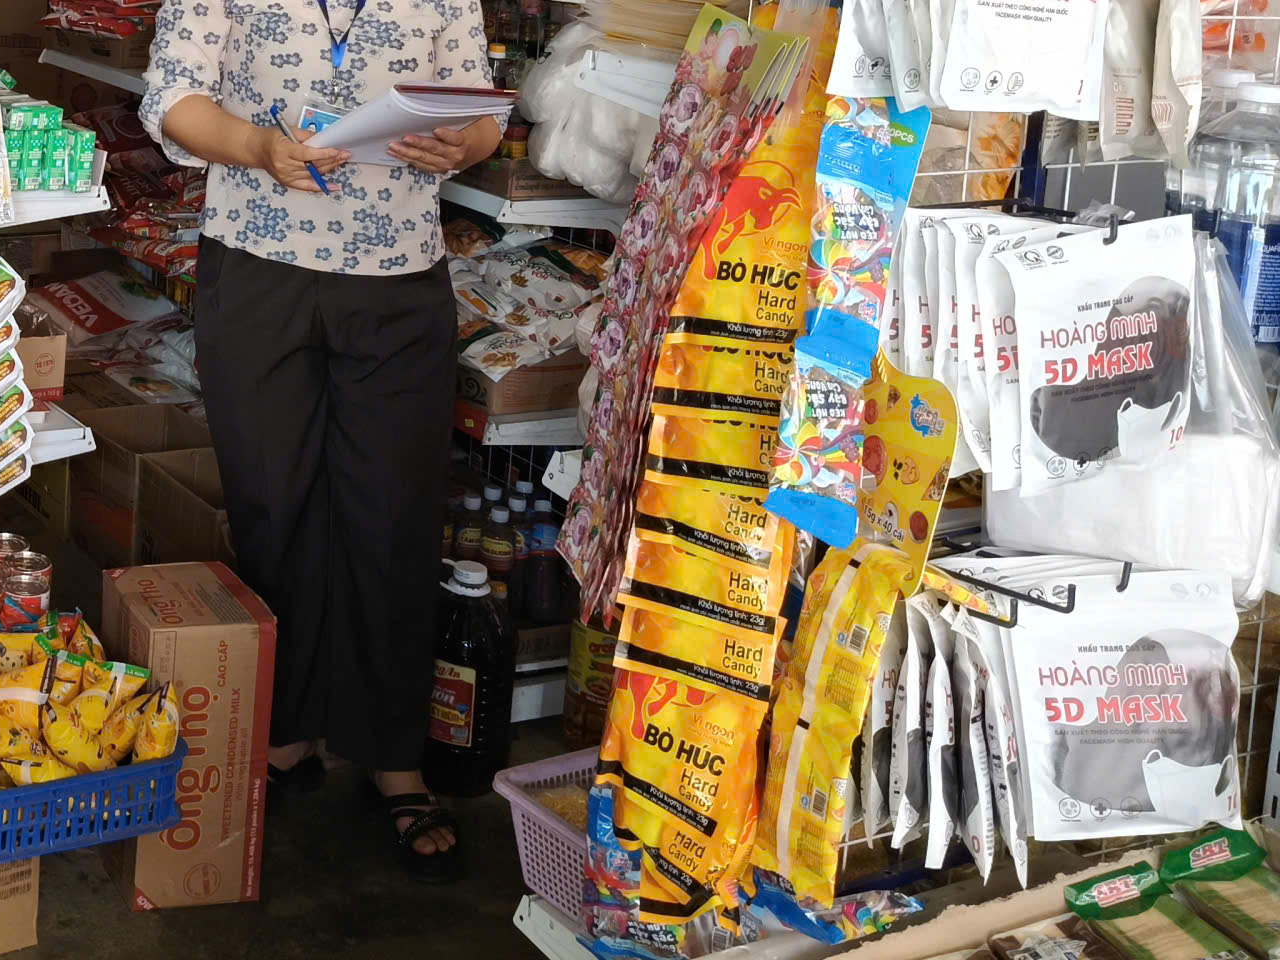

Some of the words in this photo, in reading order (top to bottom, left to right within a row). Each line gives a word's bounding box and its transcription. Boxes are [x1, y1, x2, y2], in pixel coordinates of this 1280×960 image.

[717, 257, 746, 283] BÒ
[750, 262, 801, 291] HÚC
[758, 289, 797, 311] Hard
[756, 307, 794, 327] Candy
[1040, 320, 1108, 349] HOÀNG
[1110, 311, 1157, 341] MINH
[1044, 357, 1078, 385] 5D
[1087, 342, 1154, 381] MASK
[754, 379, 784, 394] Cand
[727, 503, 768, 529] Hard
[862, 504, 876, 521] 15g
[882, 519, 893, 534] 40
[724, 521, 763, 542] Candy
[729, 571, 768, 594] Hard
[728, 590, 765, 611] Candy
[750, 614, 765, 626] 23g
[724, 639, 763, 662] Hard
[218, 665, 227, 688] CAO
[722, 656, 760, 679] Candy
[1038, 660, 1120, 687] HOÀNG
[1125, 663, 1188, 686] MINH
[745, 681, 759, 693] 23g
[232, 688, 241, 714] MILK
[1045, 697, 1085, 723] 5D
[1095, 694, 1188, 727] MASK
[705, 721, 735, 740] ngon
[227, 716, 239, 778] CONDENSED
[644, 722, 674, 753] BÒ
[676, 740, 726, 777] HÚC
[680, 768, 720, 797] Hard
[160, 764, 221, 851] Ông
[678, 785, 714, 813] Candy
[668, 843, 700, 872] Candy
[674, 831, 707, 859] Hard
